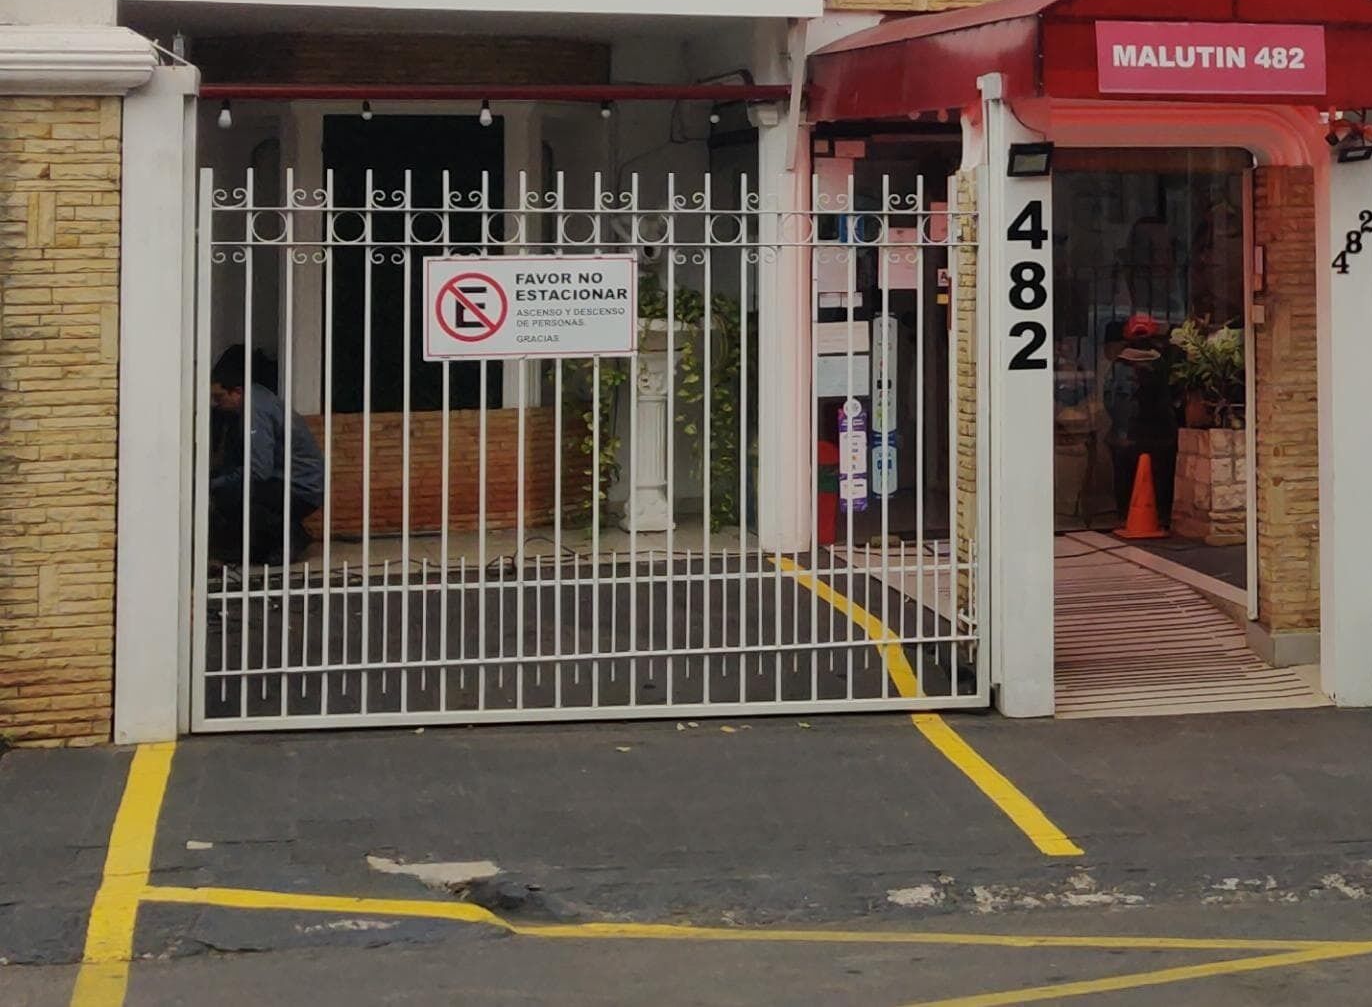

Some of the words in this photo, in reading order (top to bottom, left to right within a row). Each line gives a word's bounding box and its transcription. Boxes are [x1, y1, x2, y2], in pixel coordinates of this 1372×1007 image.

[1112, 45, 1246, 68] MALUTIN
[1254, 46, 1305, 69] 482
[515, 272, 572, 285] FAVOR
[578, 272, 603, 284] NO
[1007, 200, 1048, 370] 482
[515, 288, 628, 301] ESTACIONAR
[516, 308, 563, 317] ASCENSO
[565, 308, 572, 316] Y
[573, 307, 625, 316] DESCENSO
[516, 319, 529, 327] DE
[516, 334, 560, 343] GRACIAS
